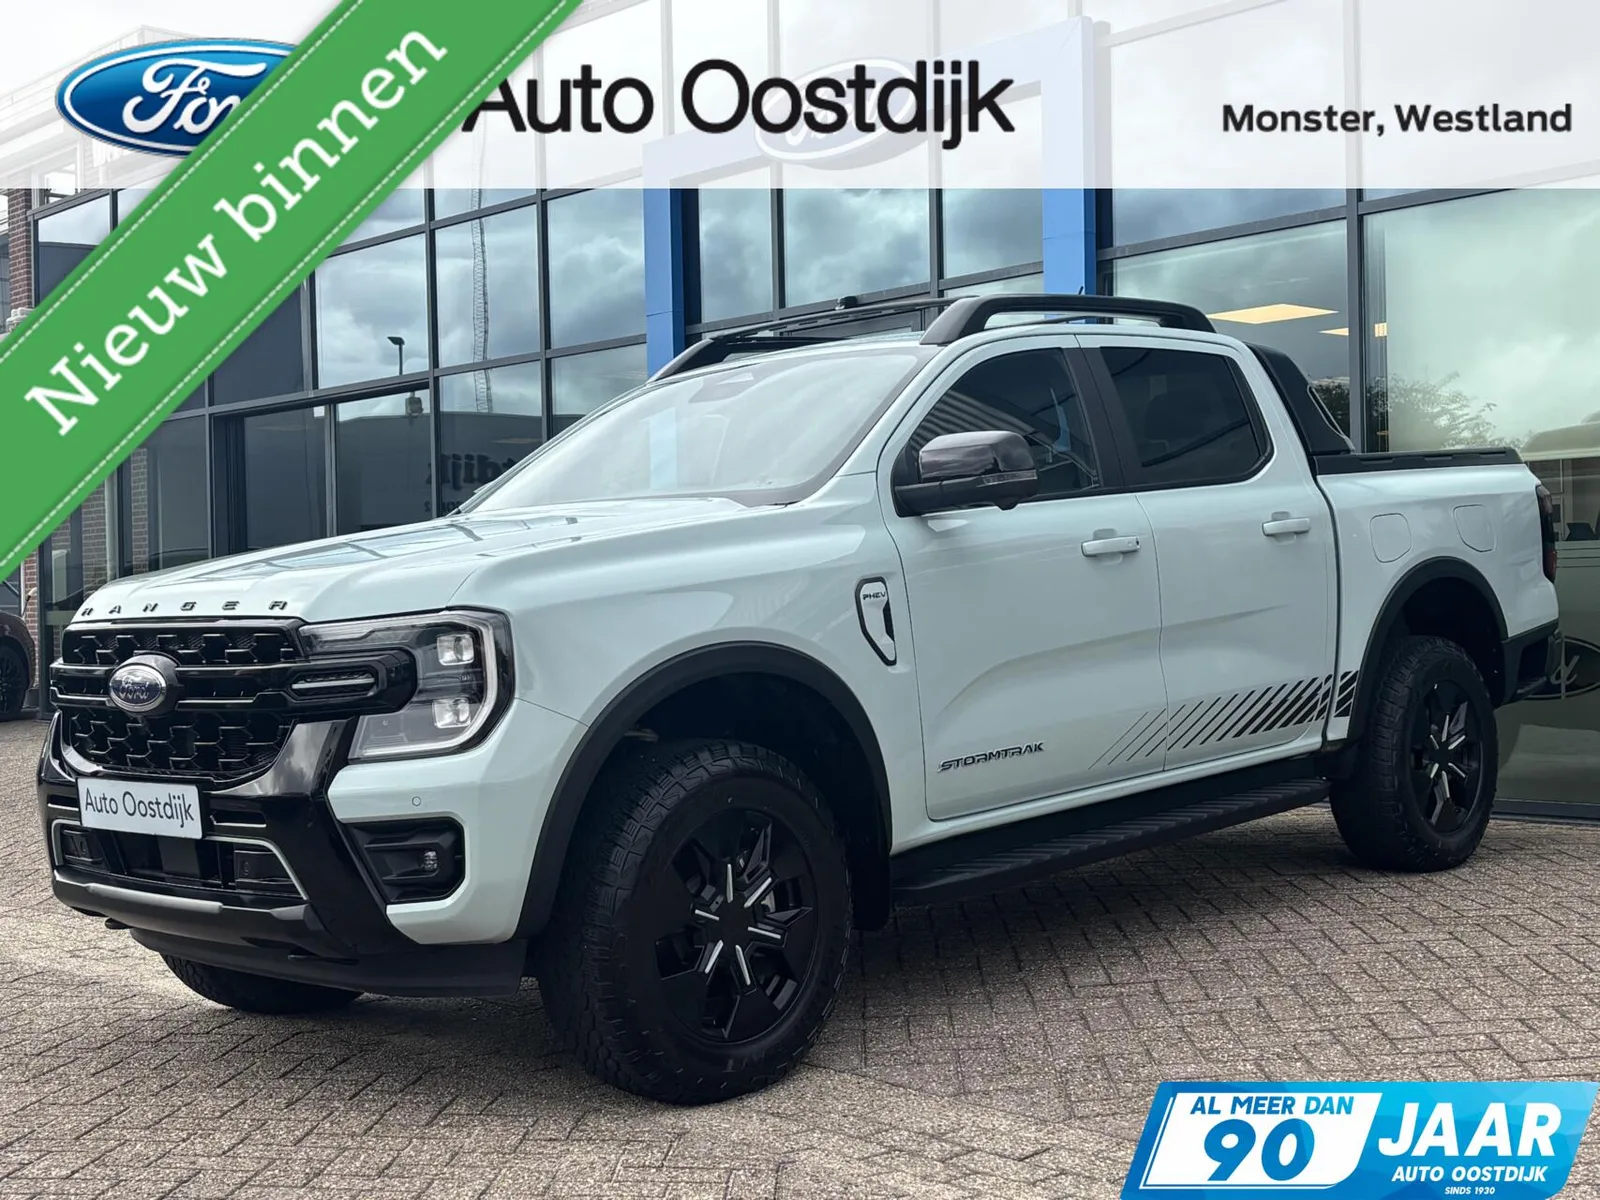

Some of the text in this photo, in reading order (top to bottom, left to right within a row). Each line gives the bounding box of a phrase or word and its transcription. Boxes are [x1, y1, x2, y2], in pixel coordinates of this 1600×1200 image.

[862, 591, 886, 600] PHEV
[81, 601, 288, 617] RANGER
[939, 742, 1044, 772] STORMTRAK
[85, 787, 195, 828] Auto Oostdijk
